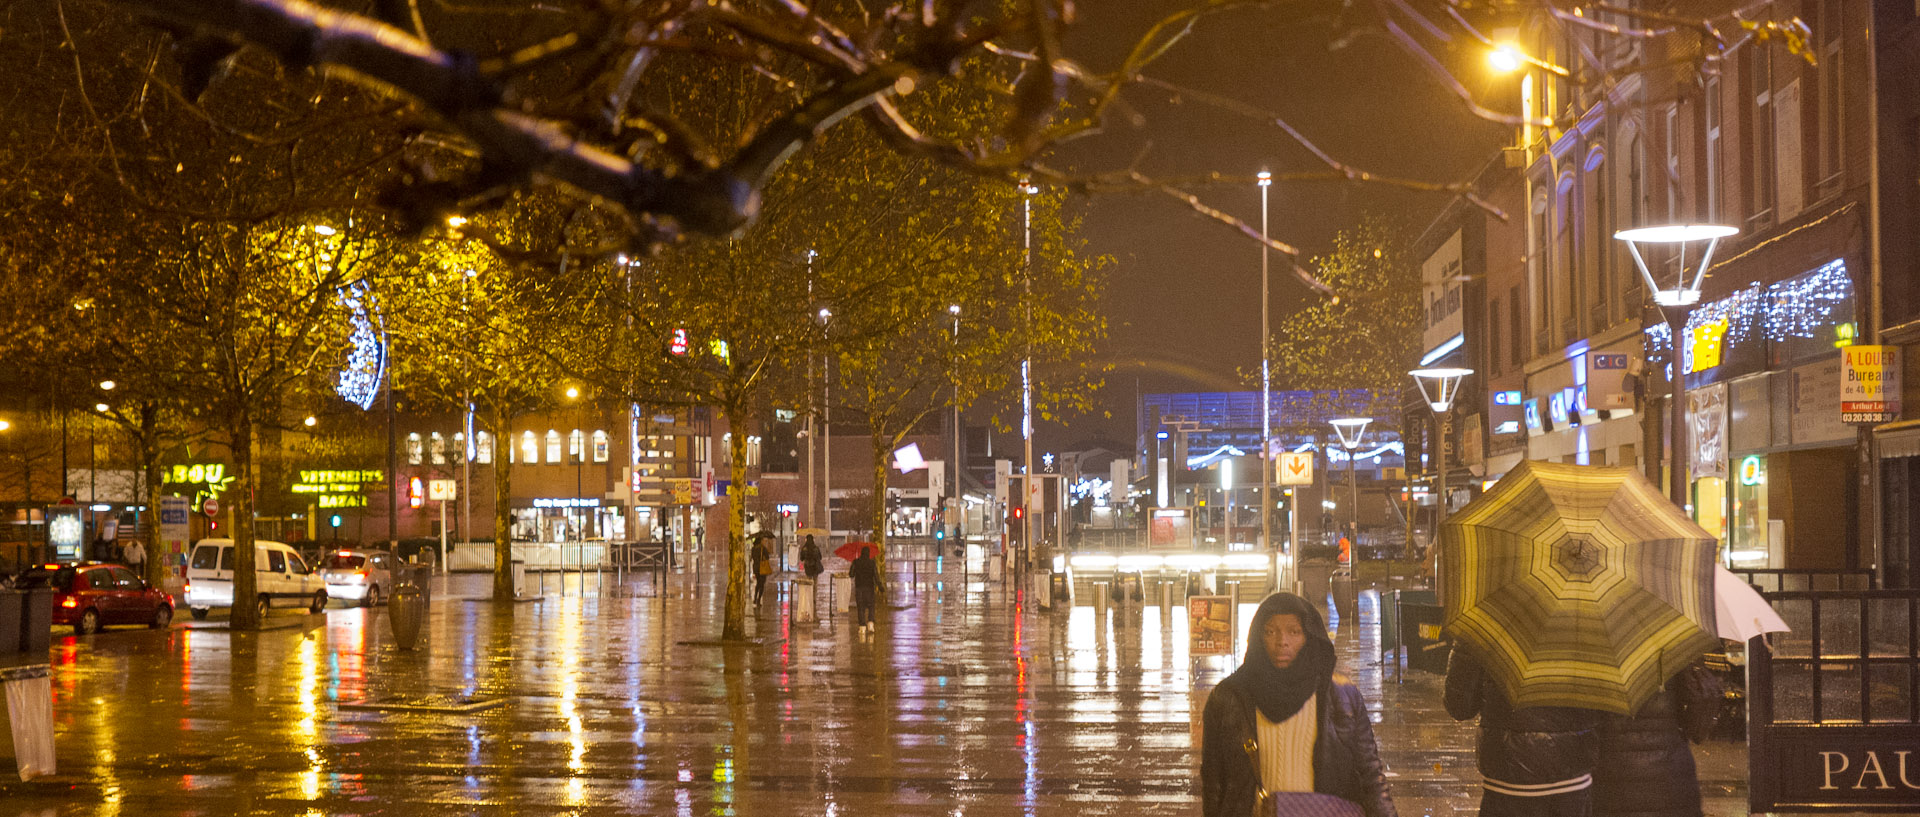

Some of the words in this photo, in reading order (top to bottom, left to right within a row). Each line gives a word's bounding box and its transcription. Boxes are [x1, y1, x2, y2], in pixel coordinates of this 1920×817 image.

[1596, 355, 1625, 368] CIC
[1846, 352, 1853, 366] A
[1858, 352, 1896, 366] LOUER
[1848, 369, 1894, 381] Bureaux
[1843, 413, 1852, 422] 03
[1853, 413, 1862, 422] 20
[1863, 413, 1872, 422] 30
[1873, 413, 1882, 422] 38
